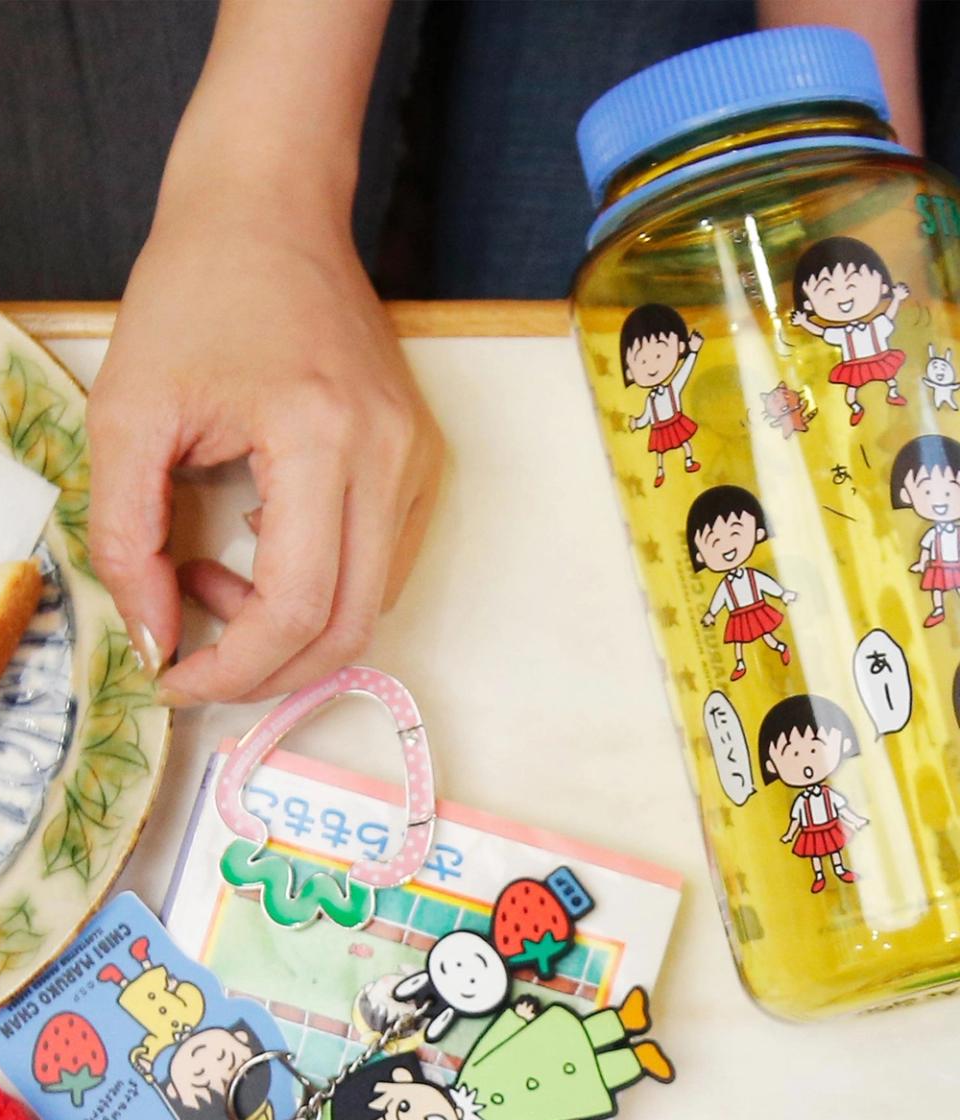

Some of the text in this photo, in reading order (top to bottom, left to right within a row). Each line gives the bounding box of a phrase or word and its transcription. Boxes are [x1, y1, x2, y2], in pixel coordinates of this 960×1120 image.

[95, 922, 131, 959] CHIBI
[39, 956, 95, 1006] MARUKO
[0, 1000, 40, 1039] CHAN
